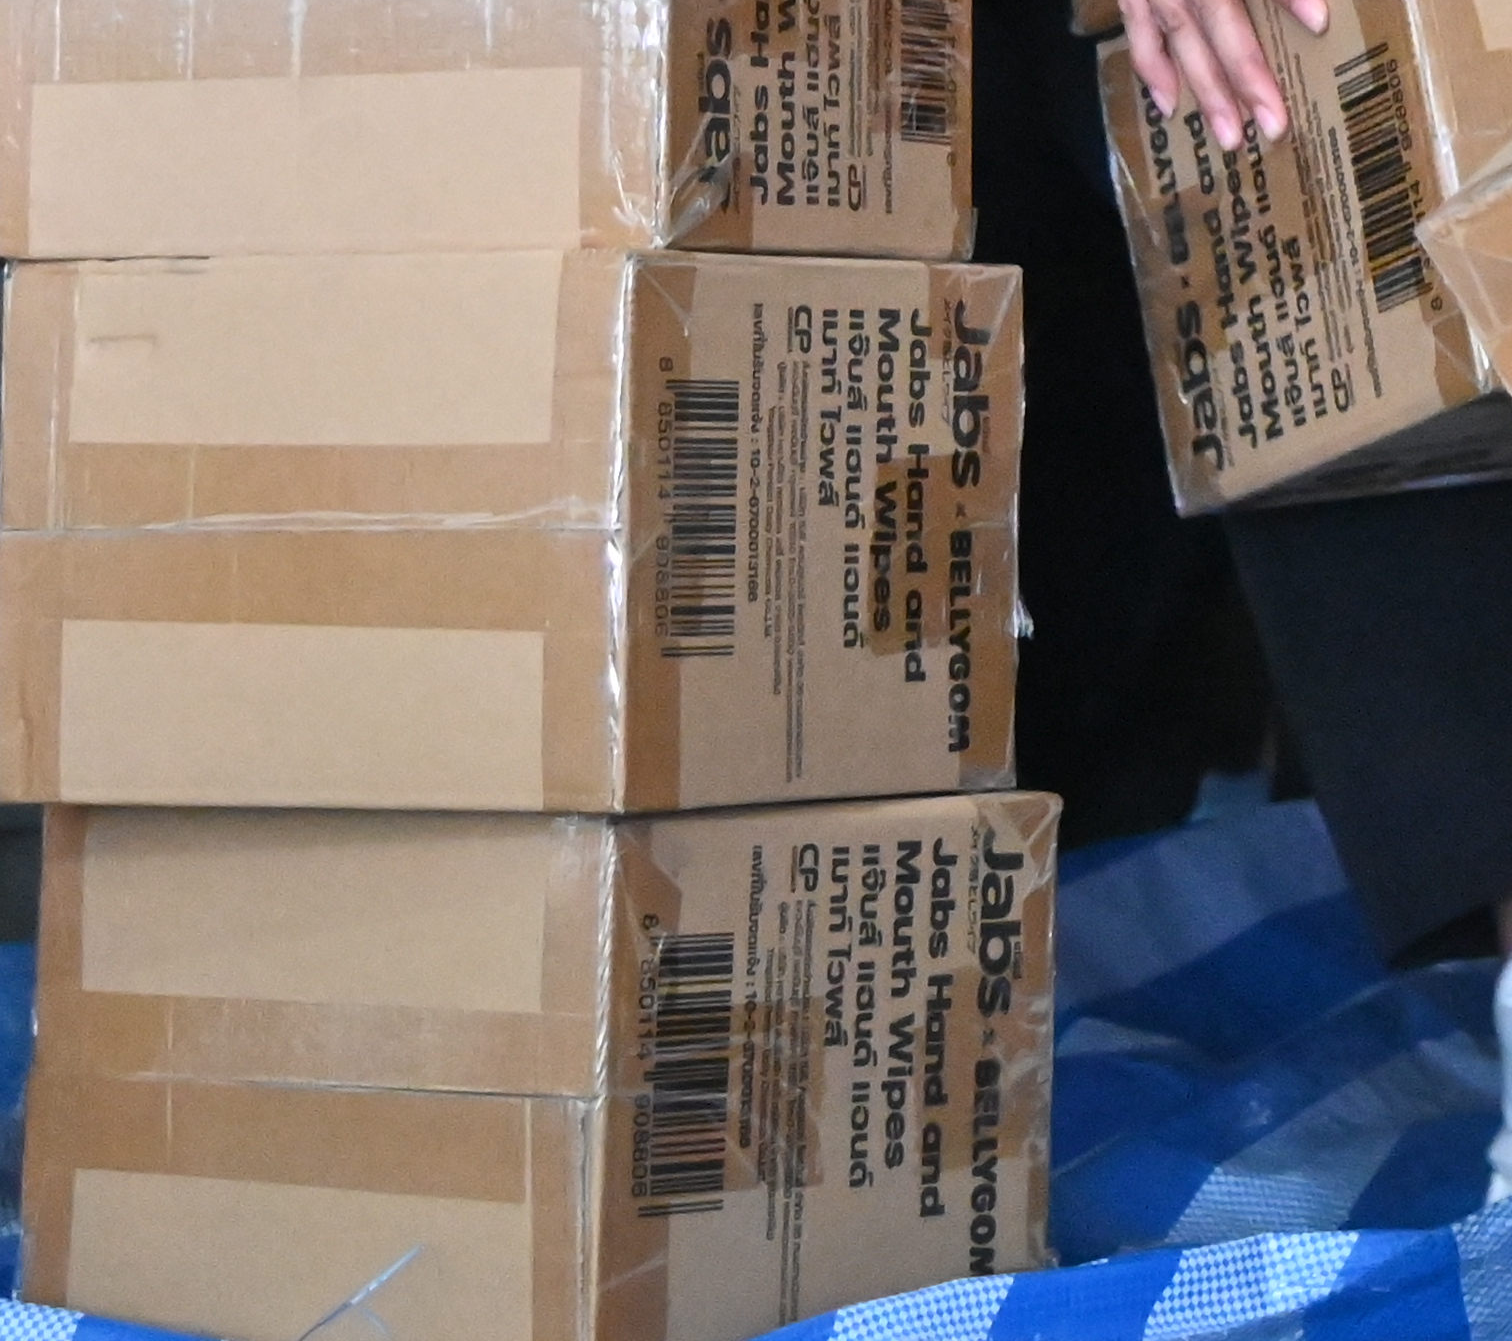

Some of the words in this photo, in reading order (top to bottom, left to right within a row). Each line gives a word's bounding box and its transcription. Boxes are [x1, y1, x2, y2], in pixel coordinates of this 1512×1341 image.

[749, 85, 769, 205] Jabs
[777, 52, 795, 206] Mouth
[848, 164, 865, 212] CP
[1184, 111, 1216, 195] and
[1203, 207, 1239, 328] Hand
[790, 305, 812, 354] CP
[876, 308, 900, 464] Mouth
[908, 308, 932, 428] Jabs
[1175, 300, 1224, 471] Jabs
[1249, 294, 1285, 440] Mouth
[1331, 368, 1351, 413] CP
[657, 397, 677, 500] 850114
[948, 300, 989, 488] Jabs
[1229, 339, 1258, 448] Jabs
[870, 481, 897, 632] Wipes
[906, 444, 930, 573] Hand
[905, 590, 926, 682] and
[948, 530, 972, 753] BELLYGOM
[794, 843, 819, 892] CP
[891, 841, 922, 998] Mouth
[929, 837, 958, 959] Jabs
[978, 828, 1024, 1017] Jabs
[881, 1013, 915, 1169] Wipes
[924, 974, 953, 1106] Hand
[919, 1122, 945, 1217] and
